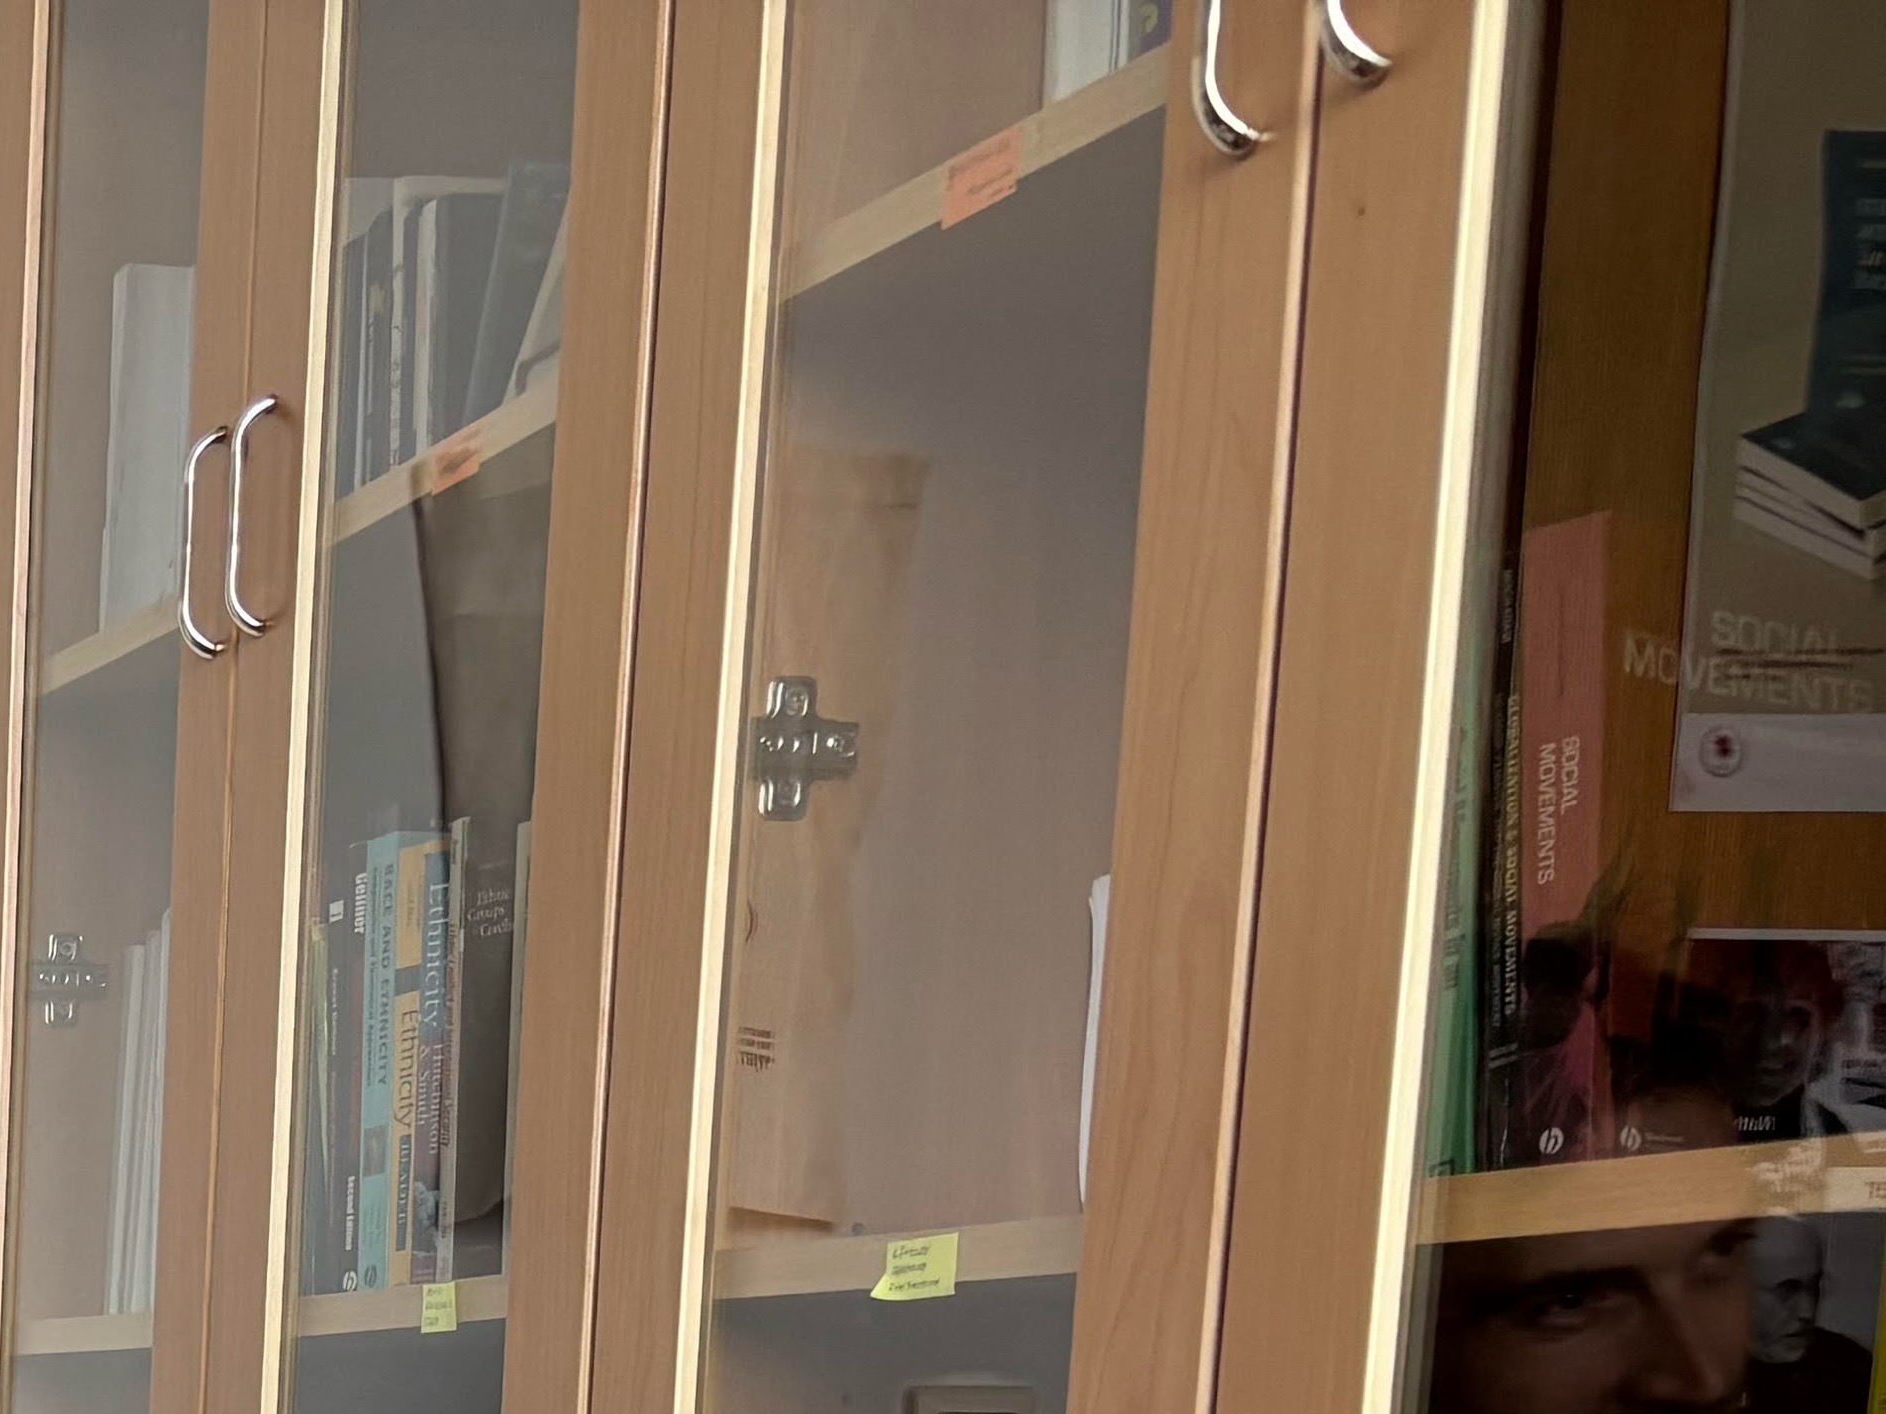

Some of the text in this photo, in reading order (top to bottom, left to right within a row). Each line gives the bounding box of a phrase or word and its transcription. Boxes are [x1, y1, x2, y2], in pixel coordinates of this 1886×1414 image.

[1538, 743, 1556, 885] MOVEMENTS
[1561, 735, 1579, 816] SOCIAL
[392, 1009, 419, 1135] Ethnicity
